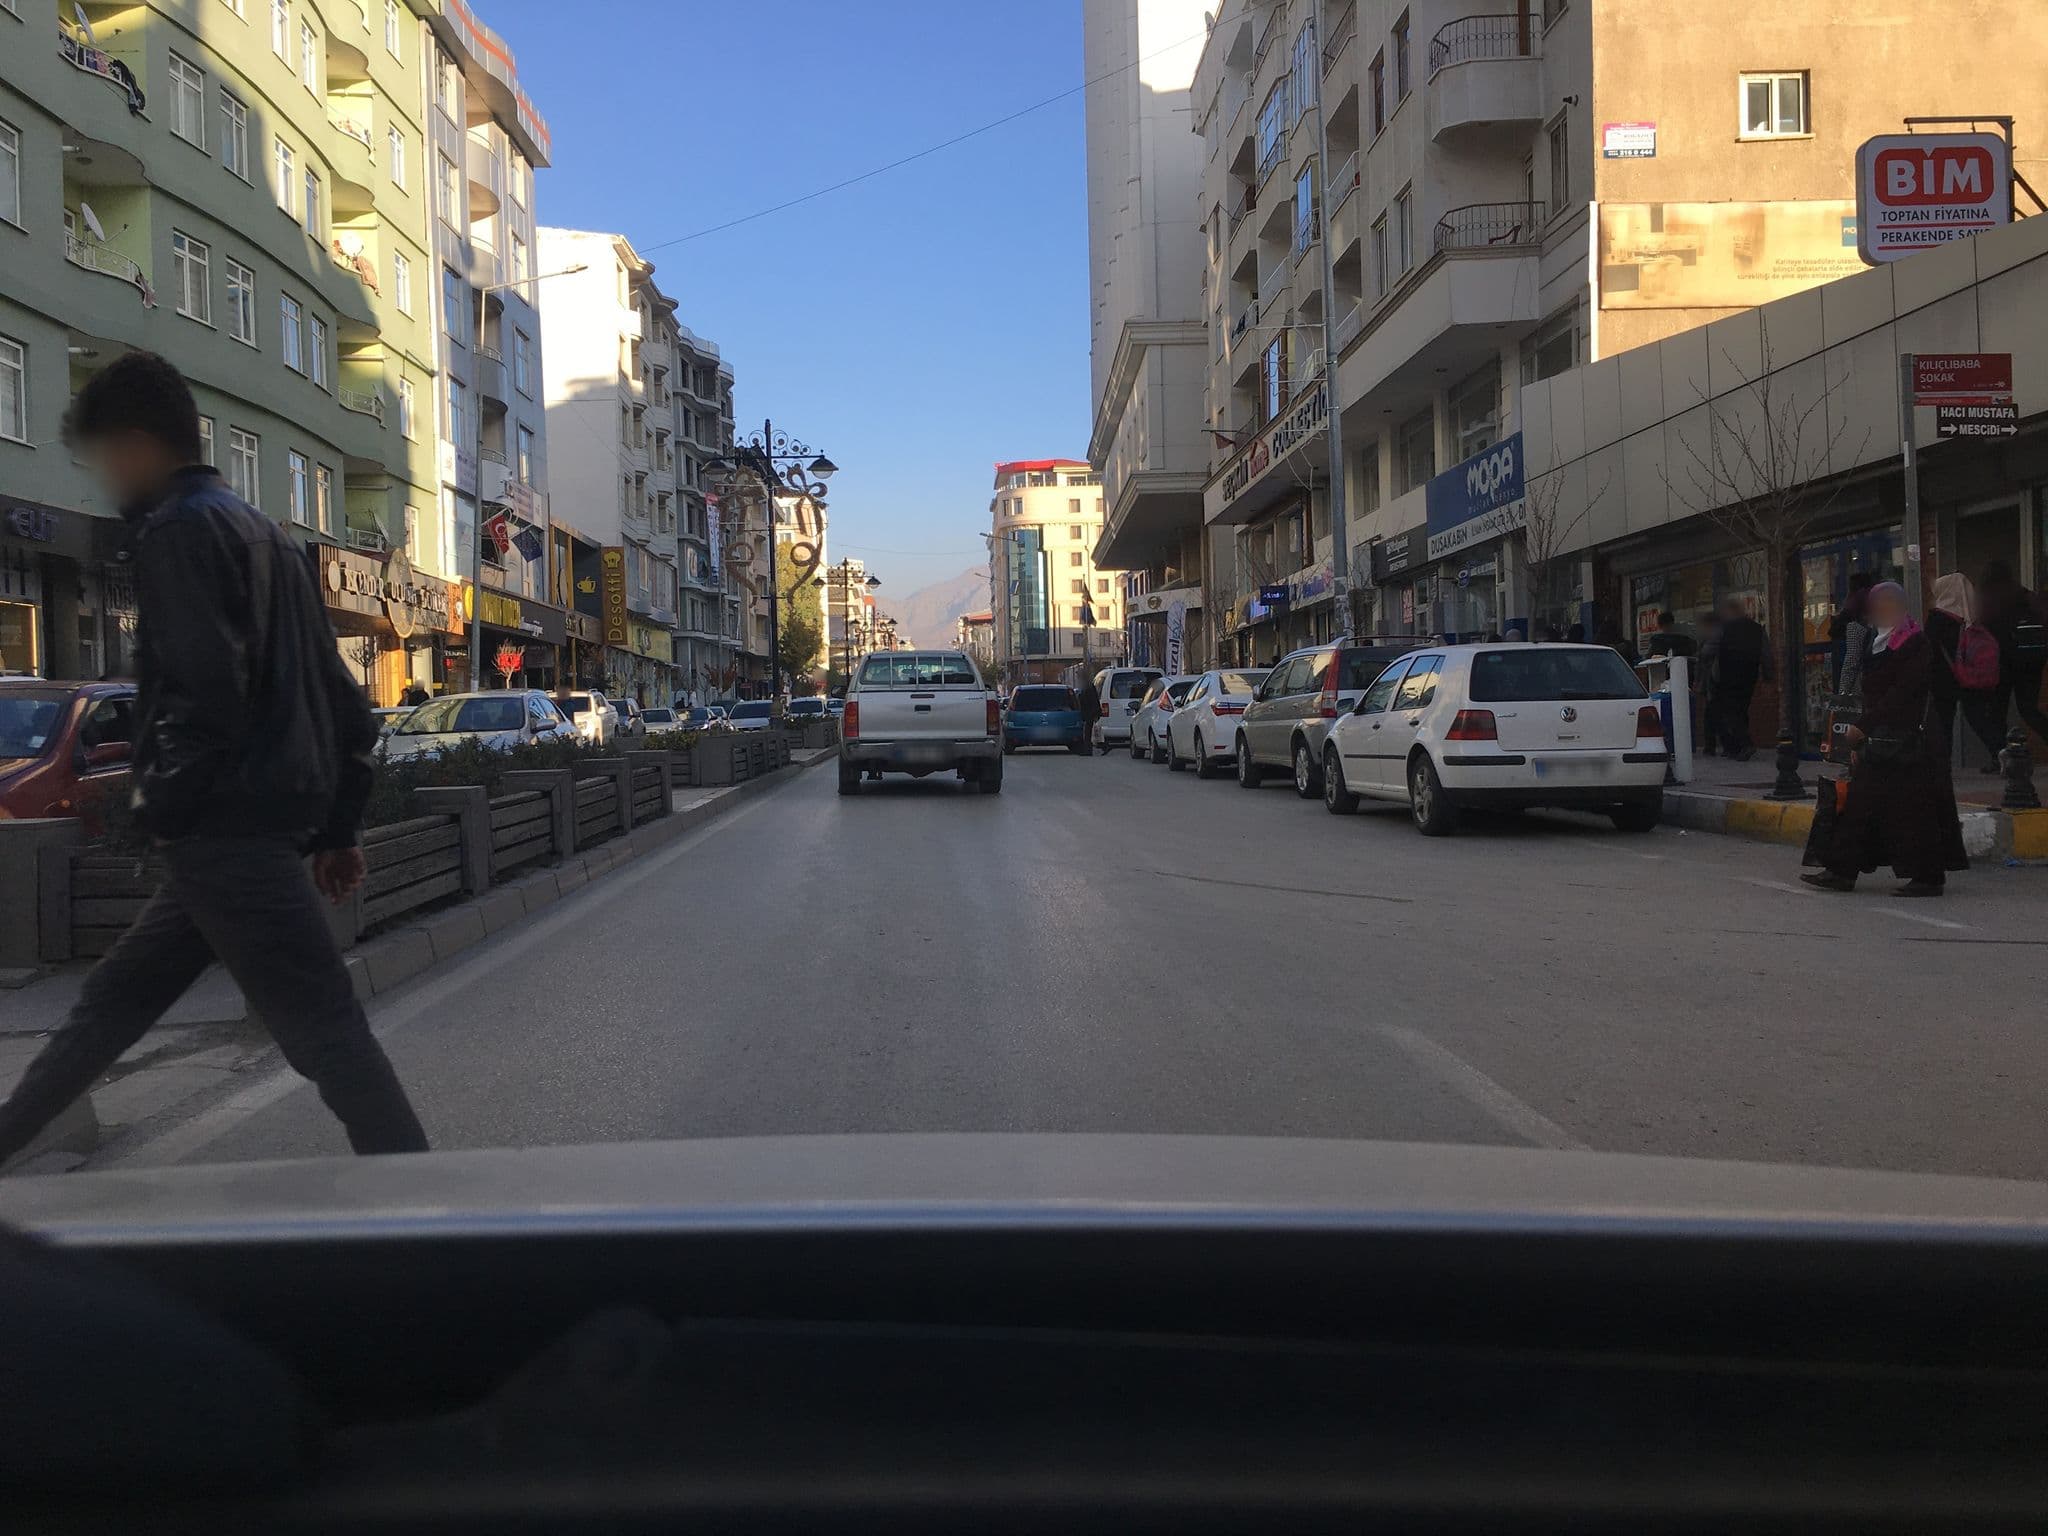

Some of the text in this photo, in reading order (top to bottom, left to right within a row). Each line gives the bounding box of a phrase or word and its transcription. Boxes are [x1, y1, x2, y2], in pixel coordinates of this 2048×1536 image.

[1881, 206, 1990, 222] TOPTAN FİYATINA
[1882, 230, 1953, 242] PERAKENDE
[1919, 359, 1981, 371] KILIÇLIBABA
[1919, 373, 1955, 383] SOKAK
[1941, 407, 2015, 418] HACI MUSTAFA
